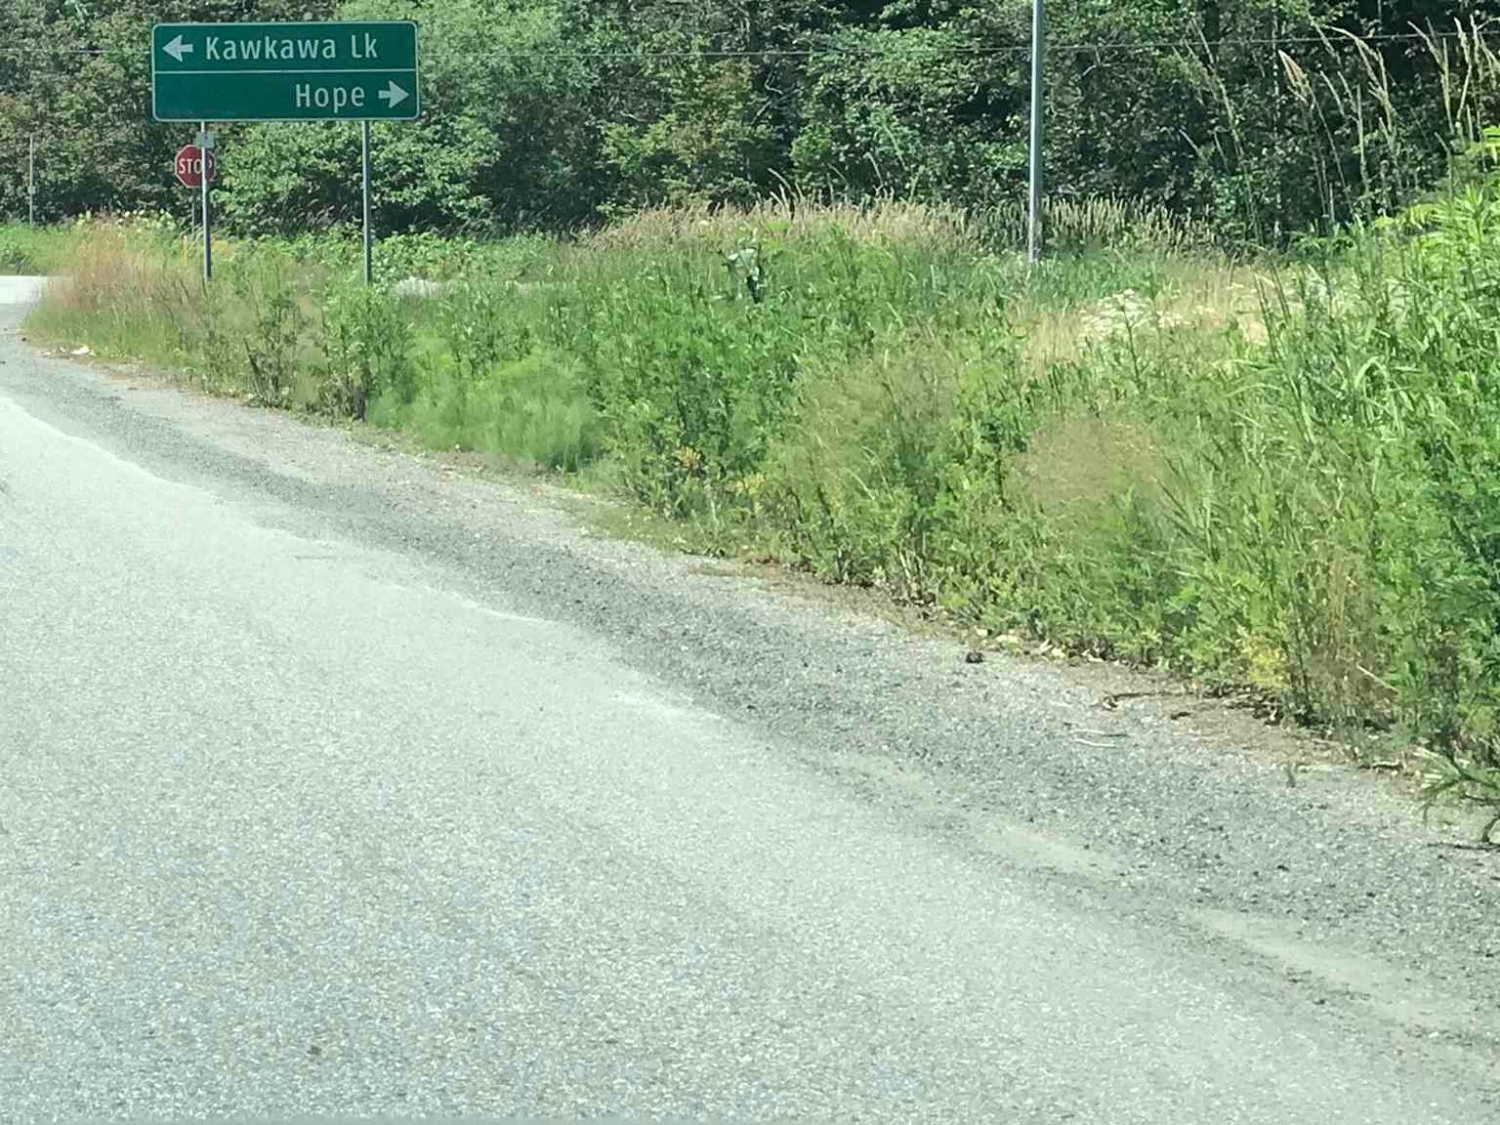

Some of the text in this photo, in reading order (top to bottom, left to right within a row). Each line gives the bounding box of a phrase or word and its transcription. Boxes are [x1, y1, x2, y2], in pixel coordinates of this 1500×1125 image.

[205, 33, 378, 60] Kawkawa Lk
[295, 84, 366, 114] Hope
